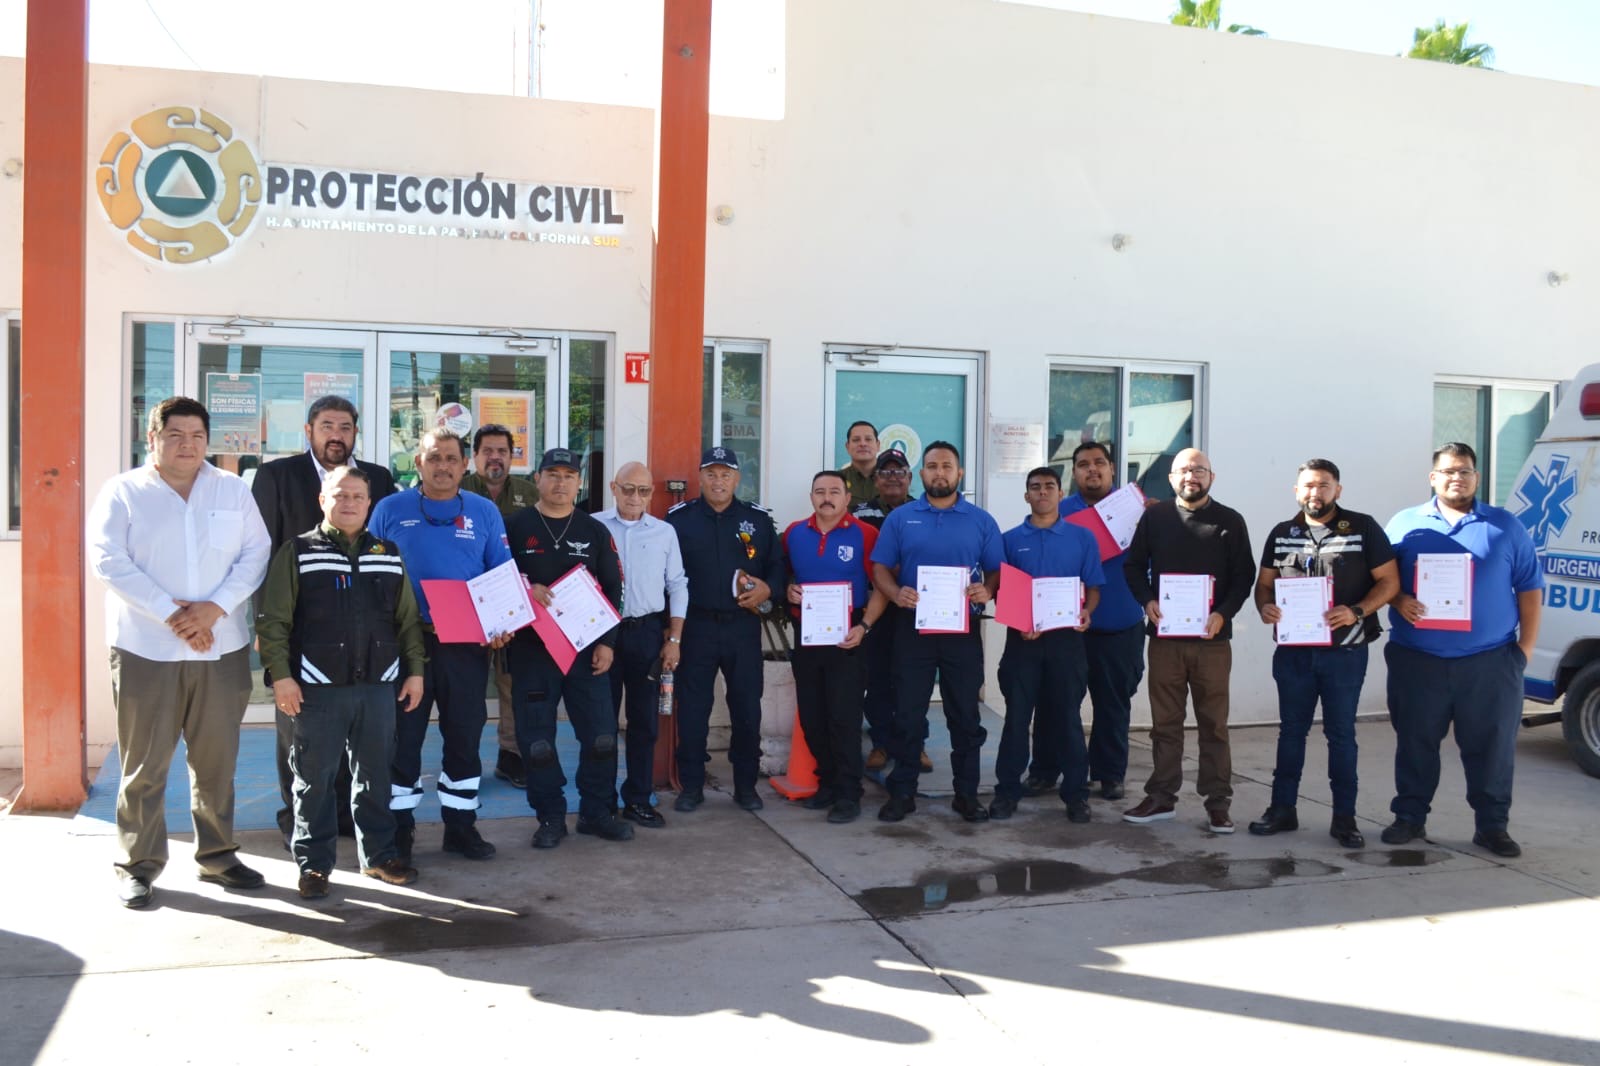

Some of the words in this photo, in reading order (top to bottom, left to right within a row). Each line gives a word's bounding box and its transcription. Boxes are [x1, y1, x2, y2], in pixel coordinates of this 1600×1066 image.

[266, 167, 516, 220] PROTECCIÓN
[529, 185, 624, 225] CIVIL
[266, 216, 281, 228] H.
[398, 224, 417, 235] DE
[419, 225, 437, 236] LA
[592, 235, 620, 247] SUR
[1547, 557, 1600, 578] URGEN
